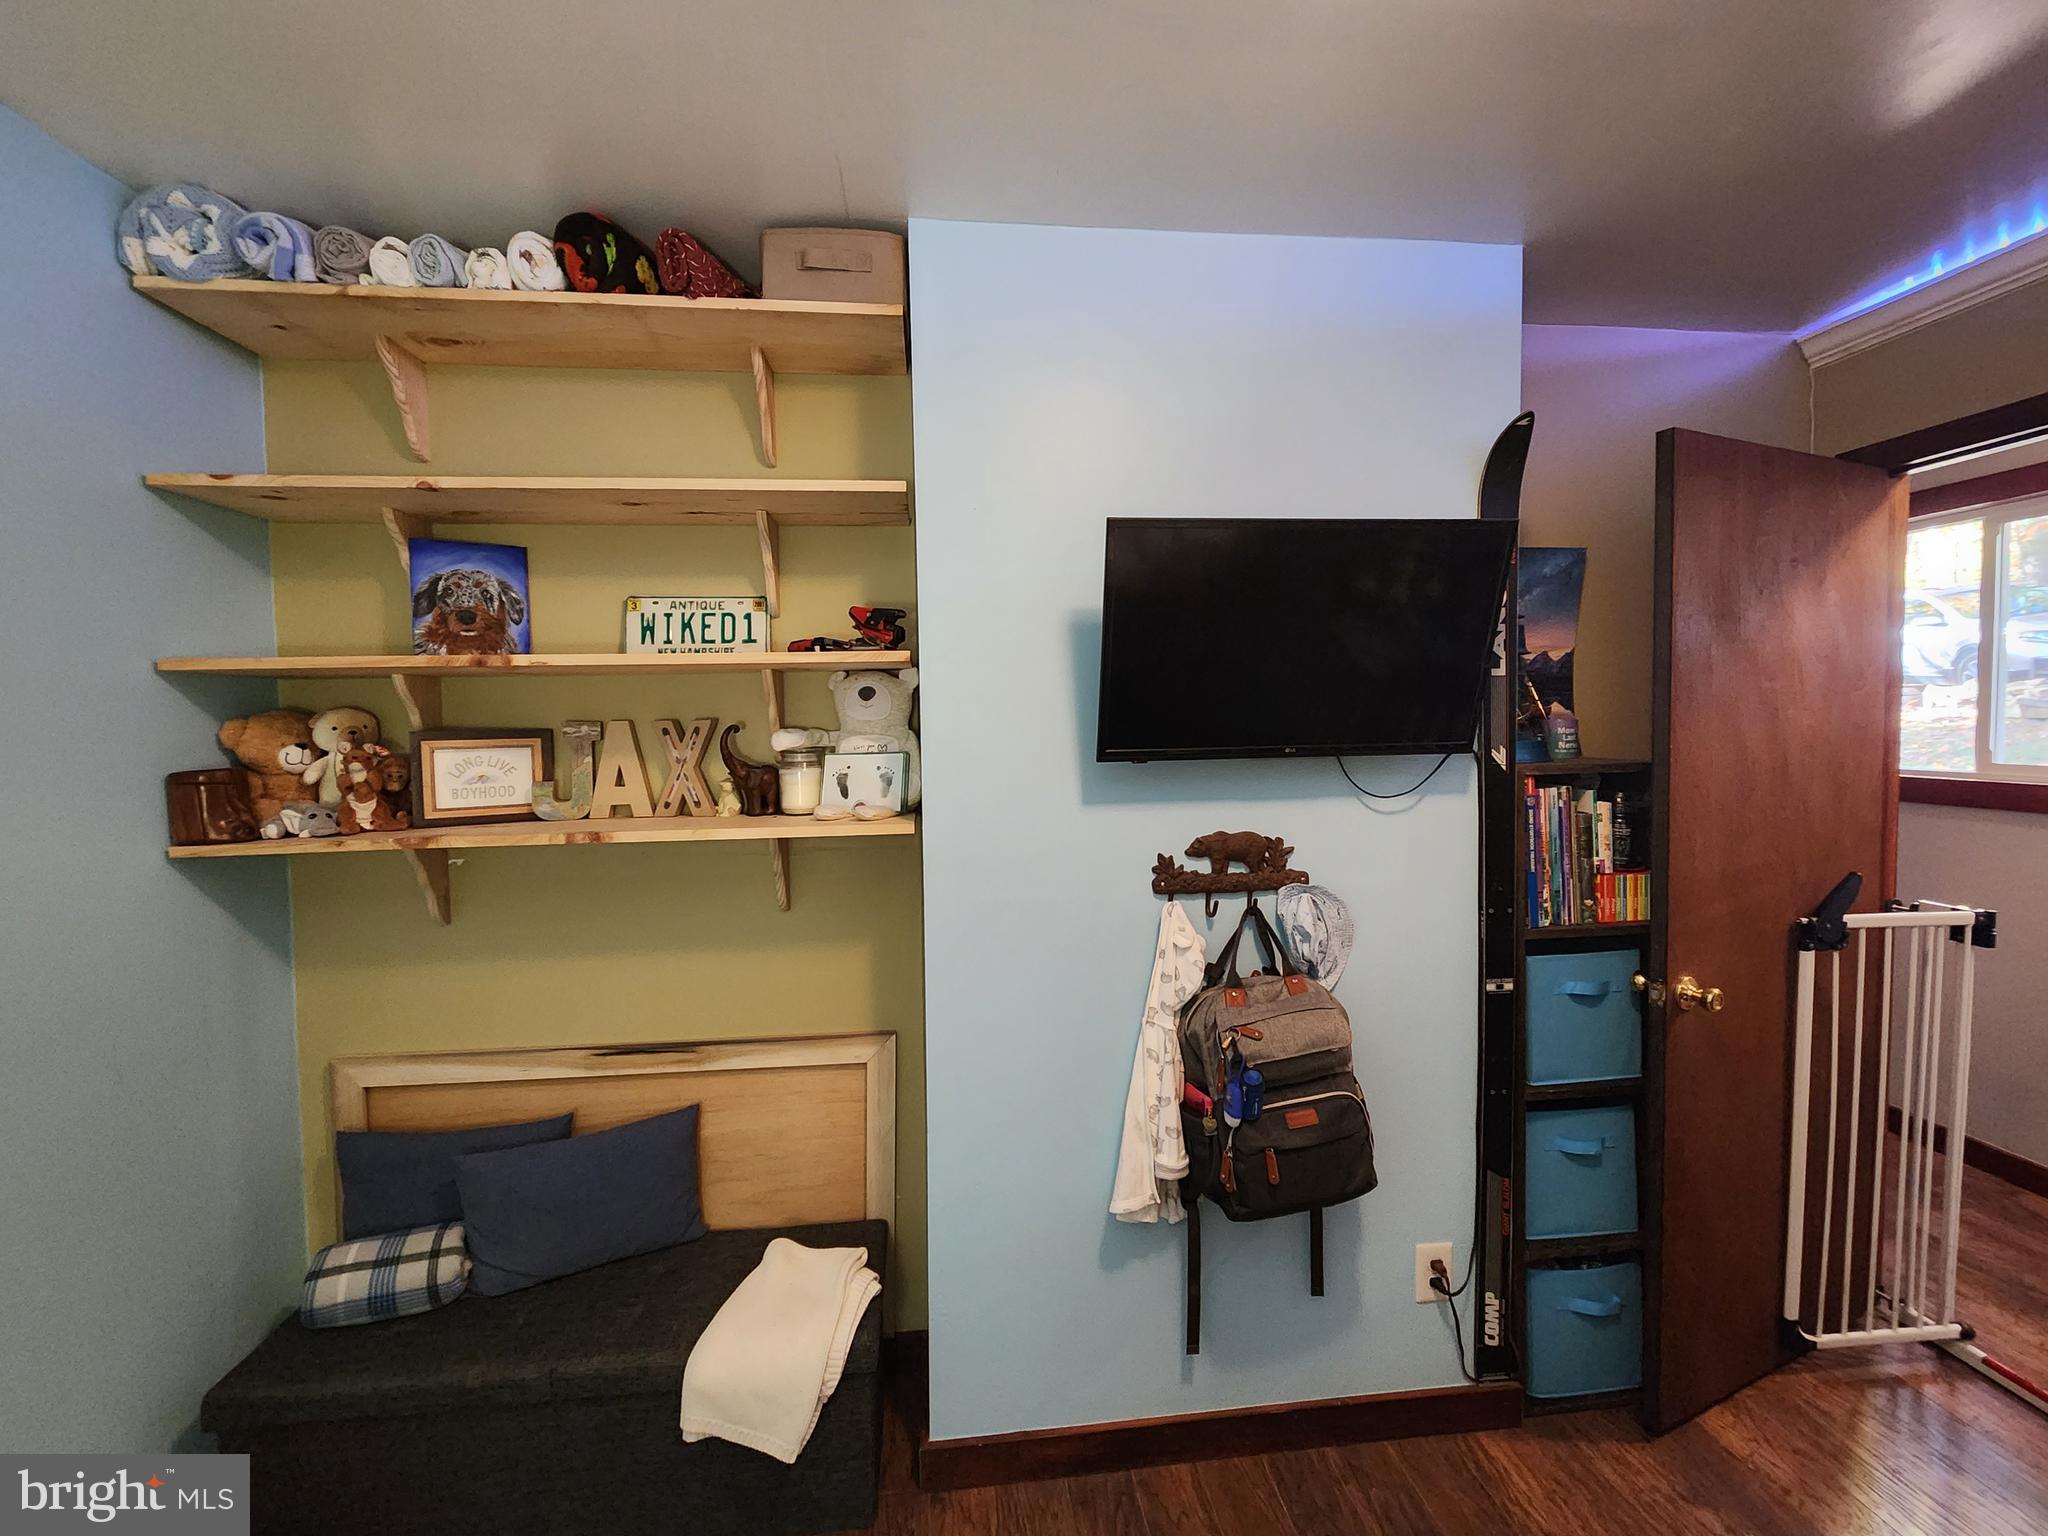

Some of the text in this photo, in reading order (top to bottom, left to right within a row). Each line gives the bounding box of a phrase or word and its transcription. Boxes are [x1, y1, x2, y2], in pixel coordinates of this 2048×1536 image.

[631, 601, 638, 610] 3
[669, 601, 725, 611] ANTIQUE
[640, 612, 758, 645] WIKED1
[448, 755, 518, 779] LONG LIVE
[531, 719, 720, 821] JAX
[451, 785, 516, 800] BOYHOOD
[1484, 1291, 1500, 1347] COMP
